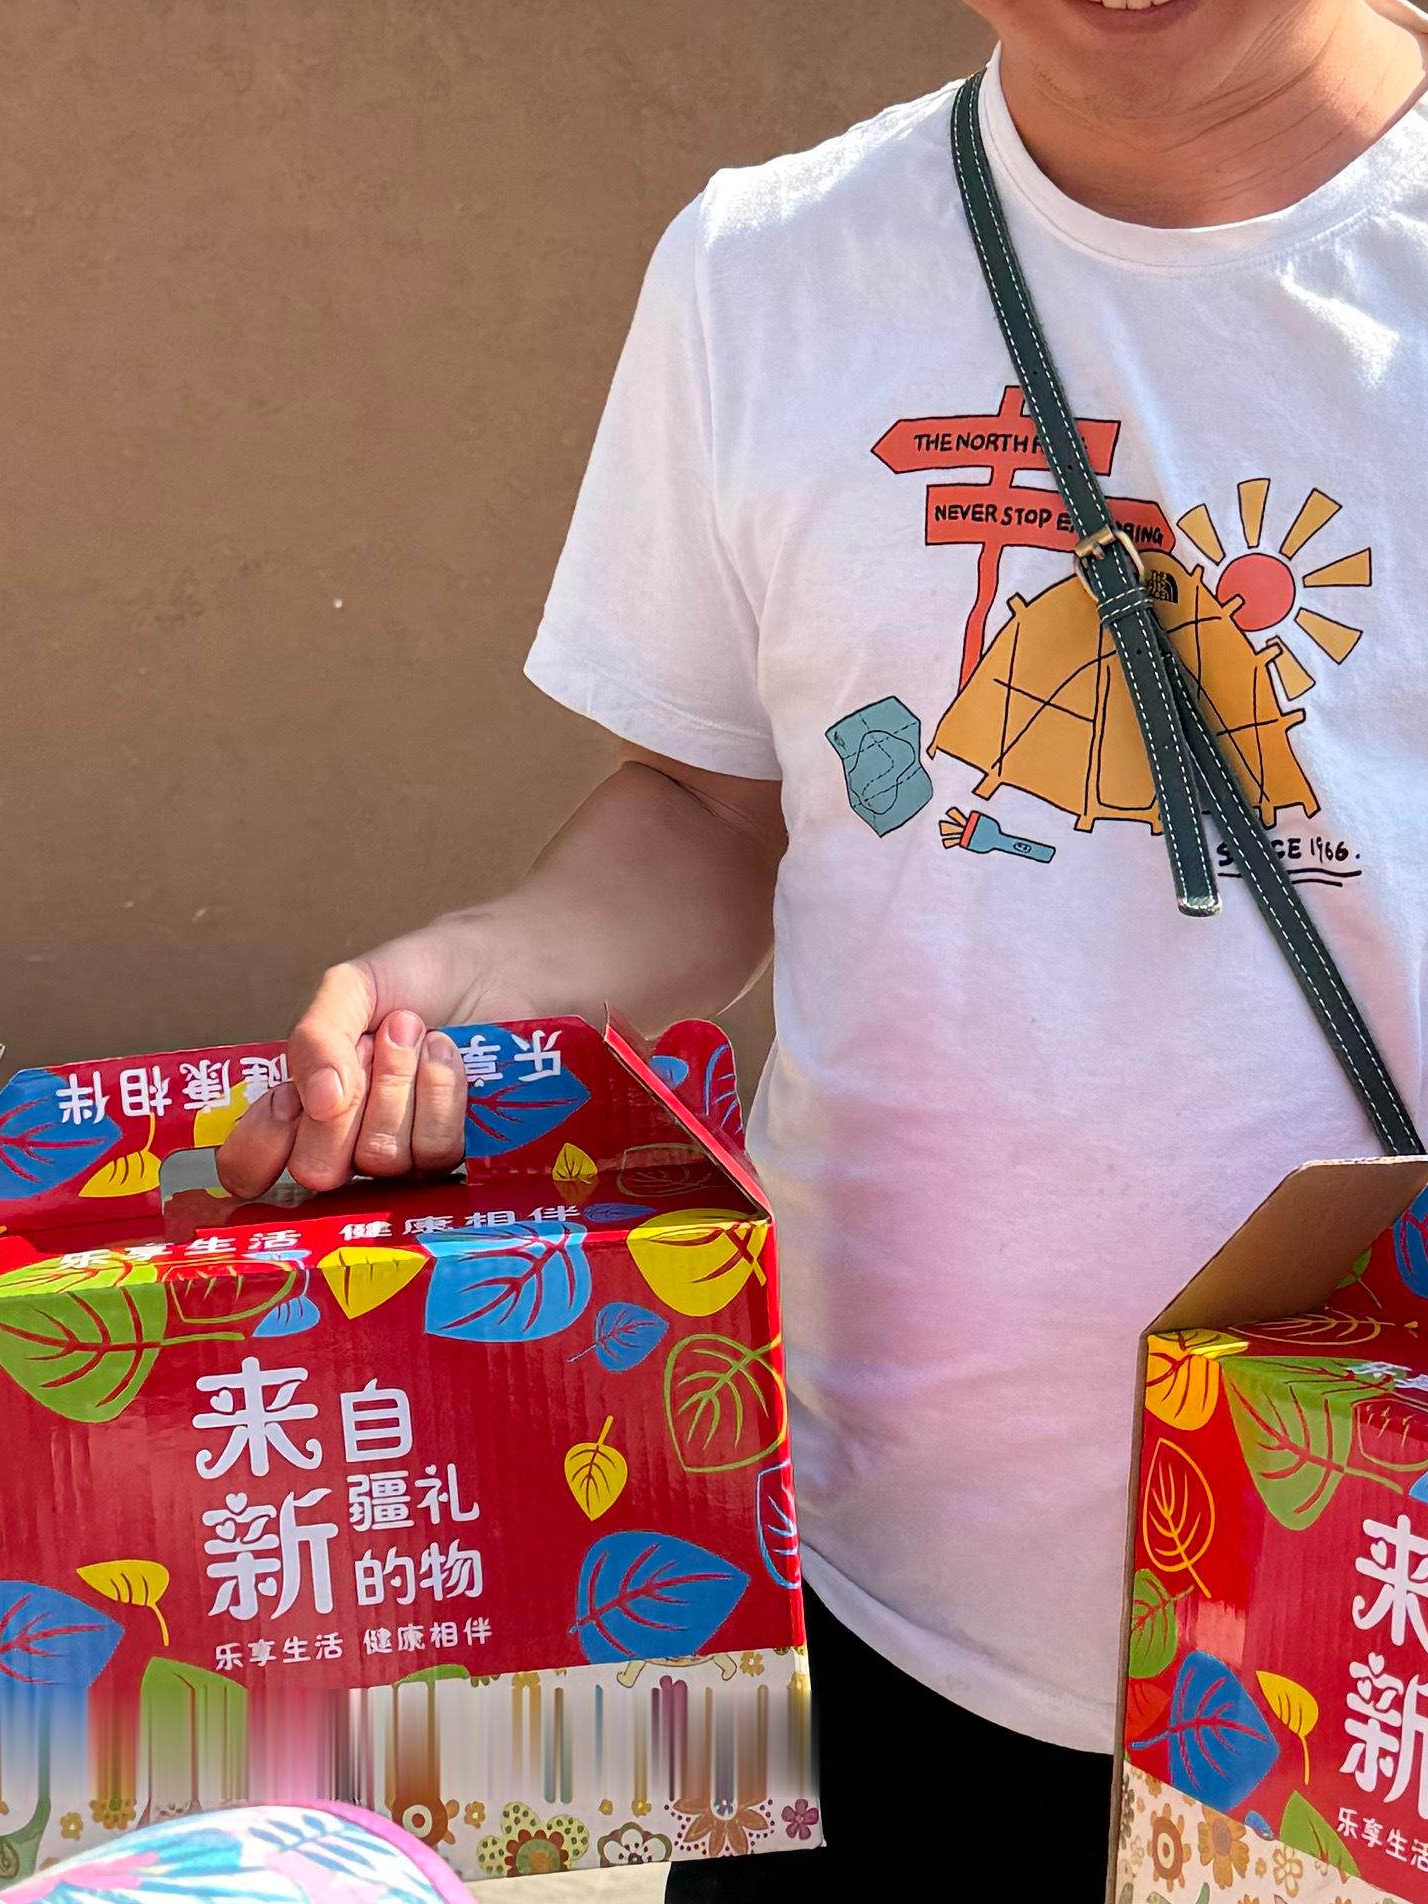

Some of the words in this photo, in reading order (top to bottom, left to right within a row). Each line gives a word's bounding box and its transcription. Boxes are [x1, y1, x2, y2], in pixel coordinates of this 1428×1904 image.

[913, 433, 952, 452] THE
[956, 431, 1029, 454] NORTH
[934, 504, 998, 523] NEVER
[1000, 507, 1053, 529] STOP
[1056, 512, 1164, 547] ERING
[1216, 837, 1302, 867] SCE
[60, 1228, 303, 1271] 乐享生活
[339, 1205, 581, 1241] 健康相伴
[215, 1631, 344, 1671] 乐享生活
[362, 1616, 492, 1656] 健康相伴
